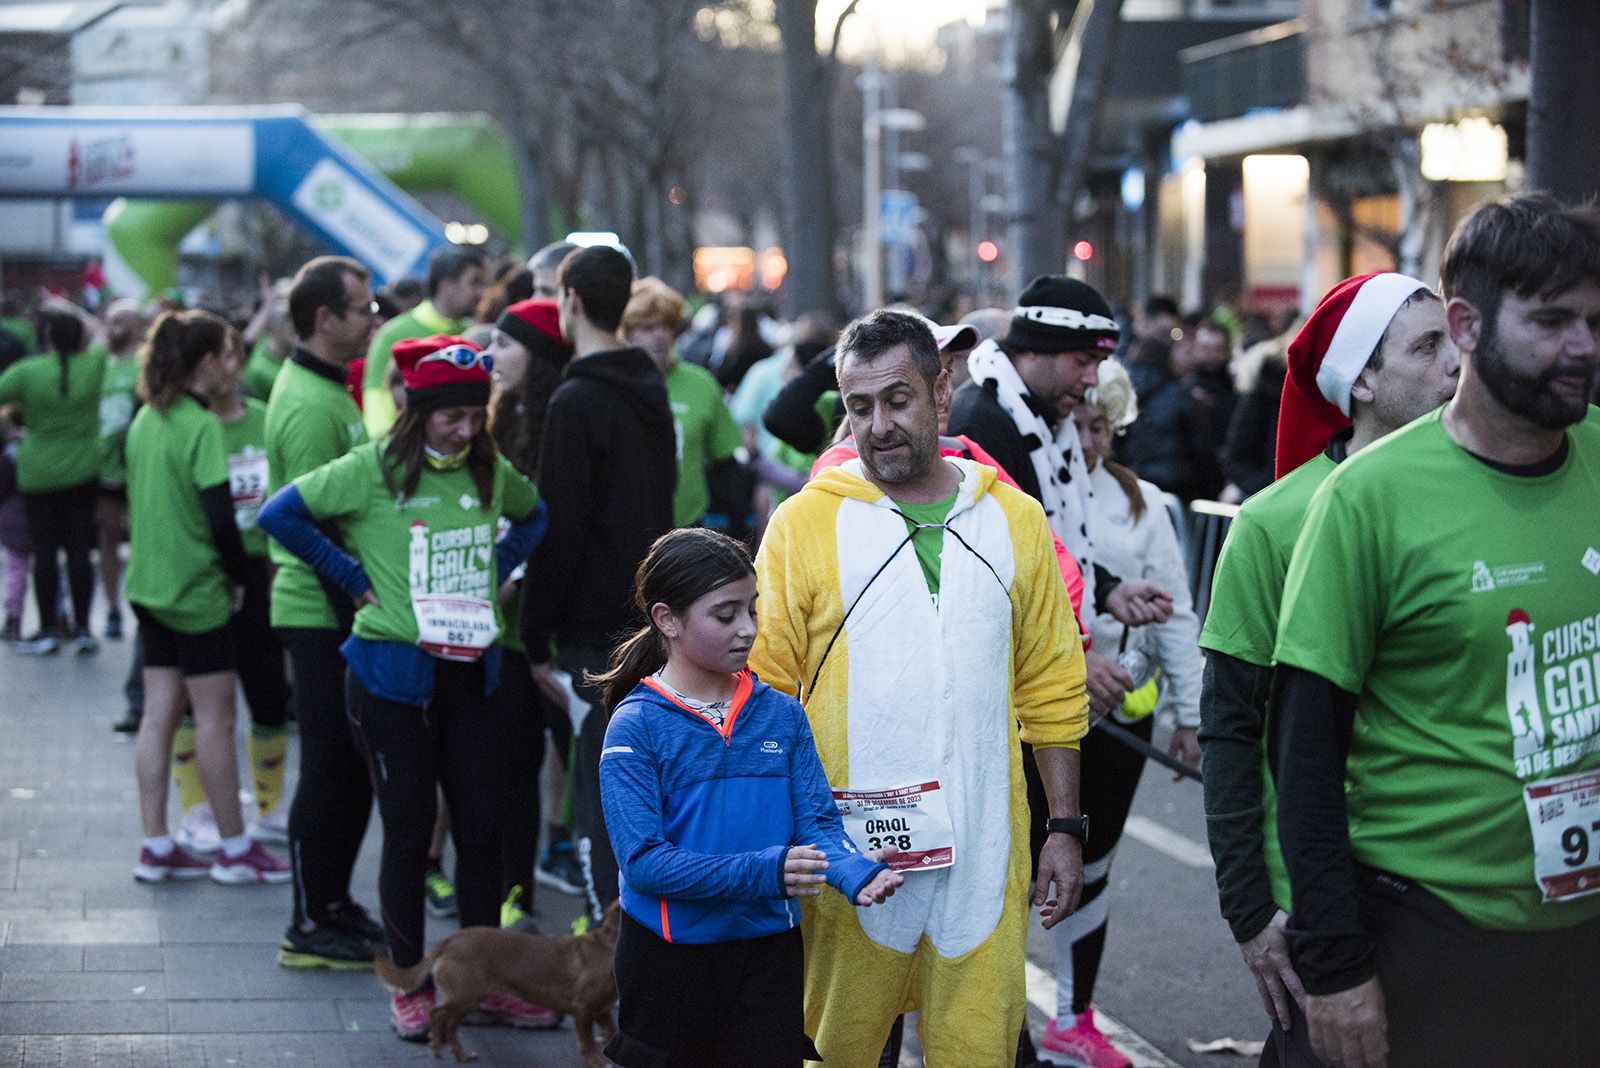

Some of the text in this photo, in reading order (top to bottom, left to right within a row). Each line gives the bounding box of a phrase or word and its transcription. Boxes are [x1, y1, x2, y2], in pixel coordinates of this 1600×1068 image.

[1515, 756, 1533, 778] 31
[1533, 749, 1552, 773] DE
[906, 794, 922, 804] 2023
[865, 817, 911, 835] ORIOL
[868, 834, 912, 851] 338
